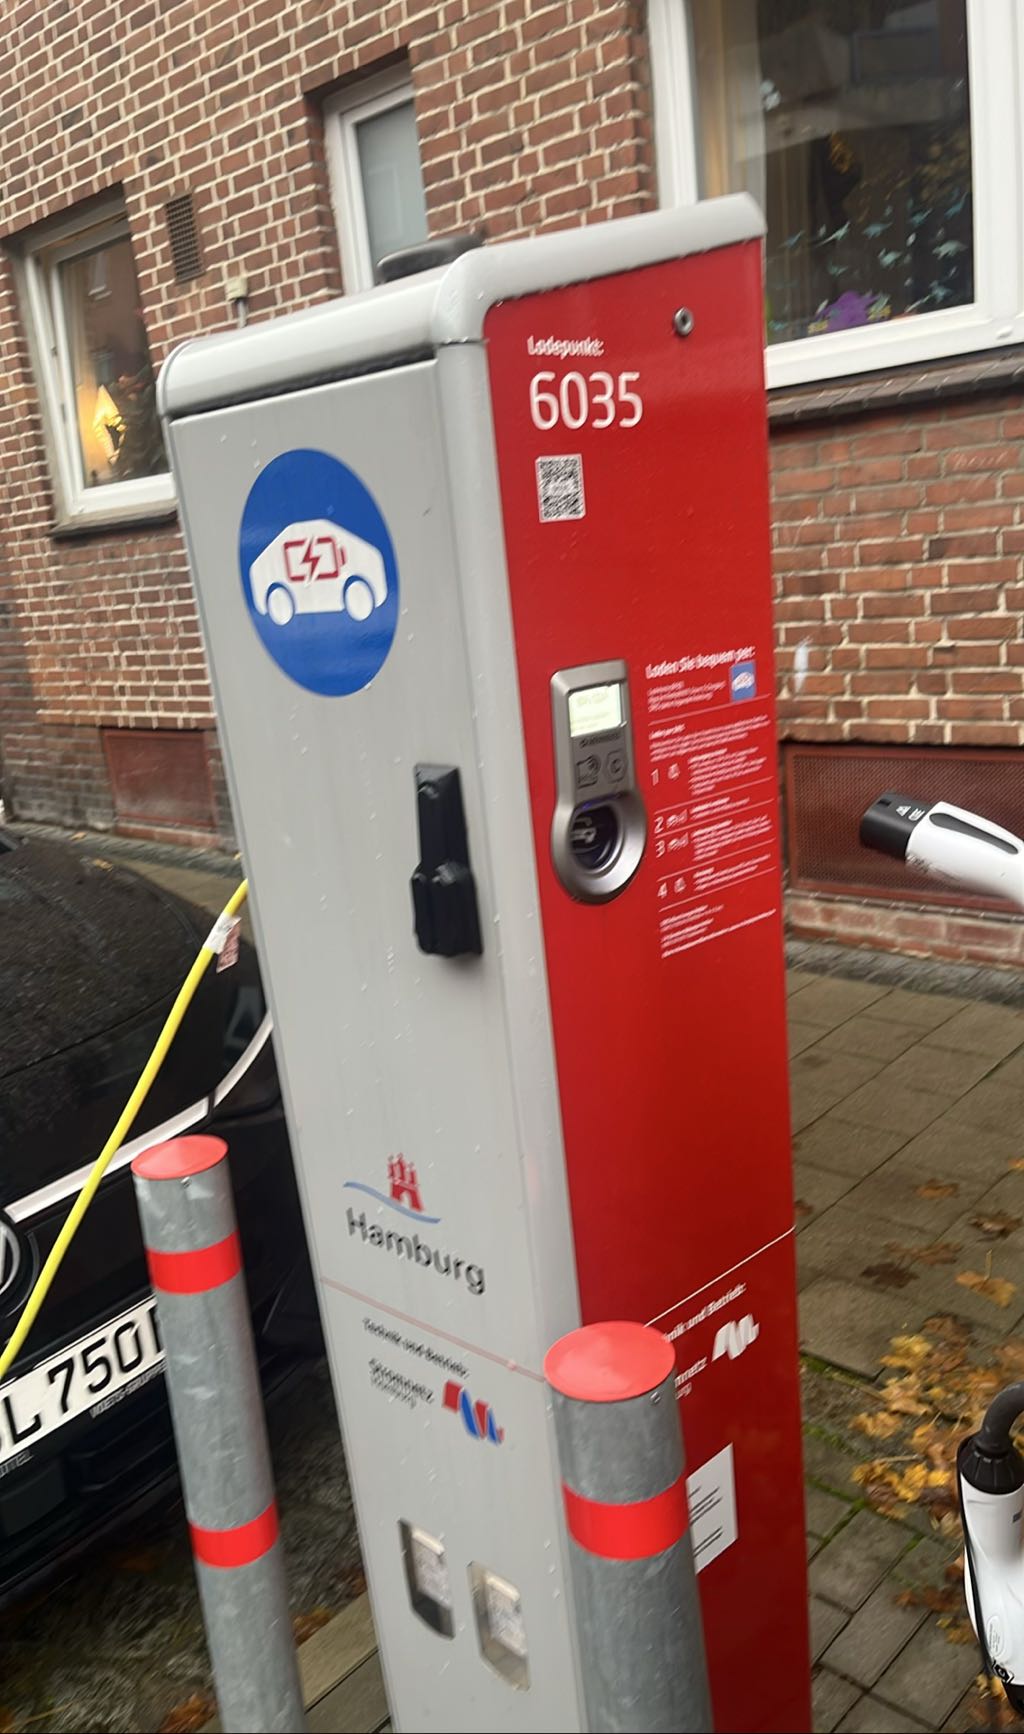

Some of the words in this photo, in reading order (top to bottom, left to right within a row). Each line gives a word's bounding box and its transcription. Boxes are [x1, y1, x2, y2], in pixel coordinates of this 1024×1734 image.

[529, 370, 644, 430] 6035
[651, 768, 660, 787] 1
[654, 816, 664, 834] 2
[656, 839, 666, 858] 3
[657, 882, 668, 899] 4
[345, 1206, 486, 1296] Hamburg
